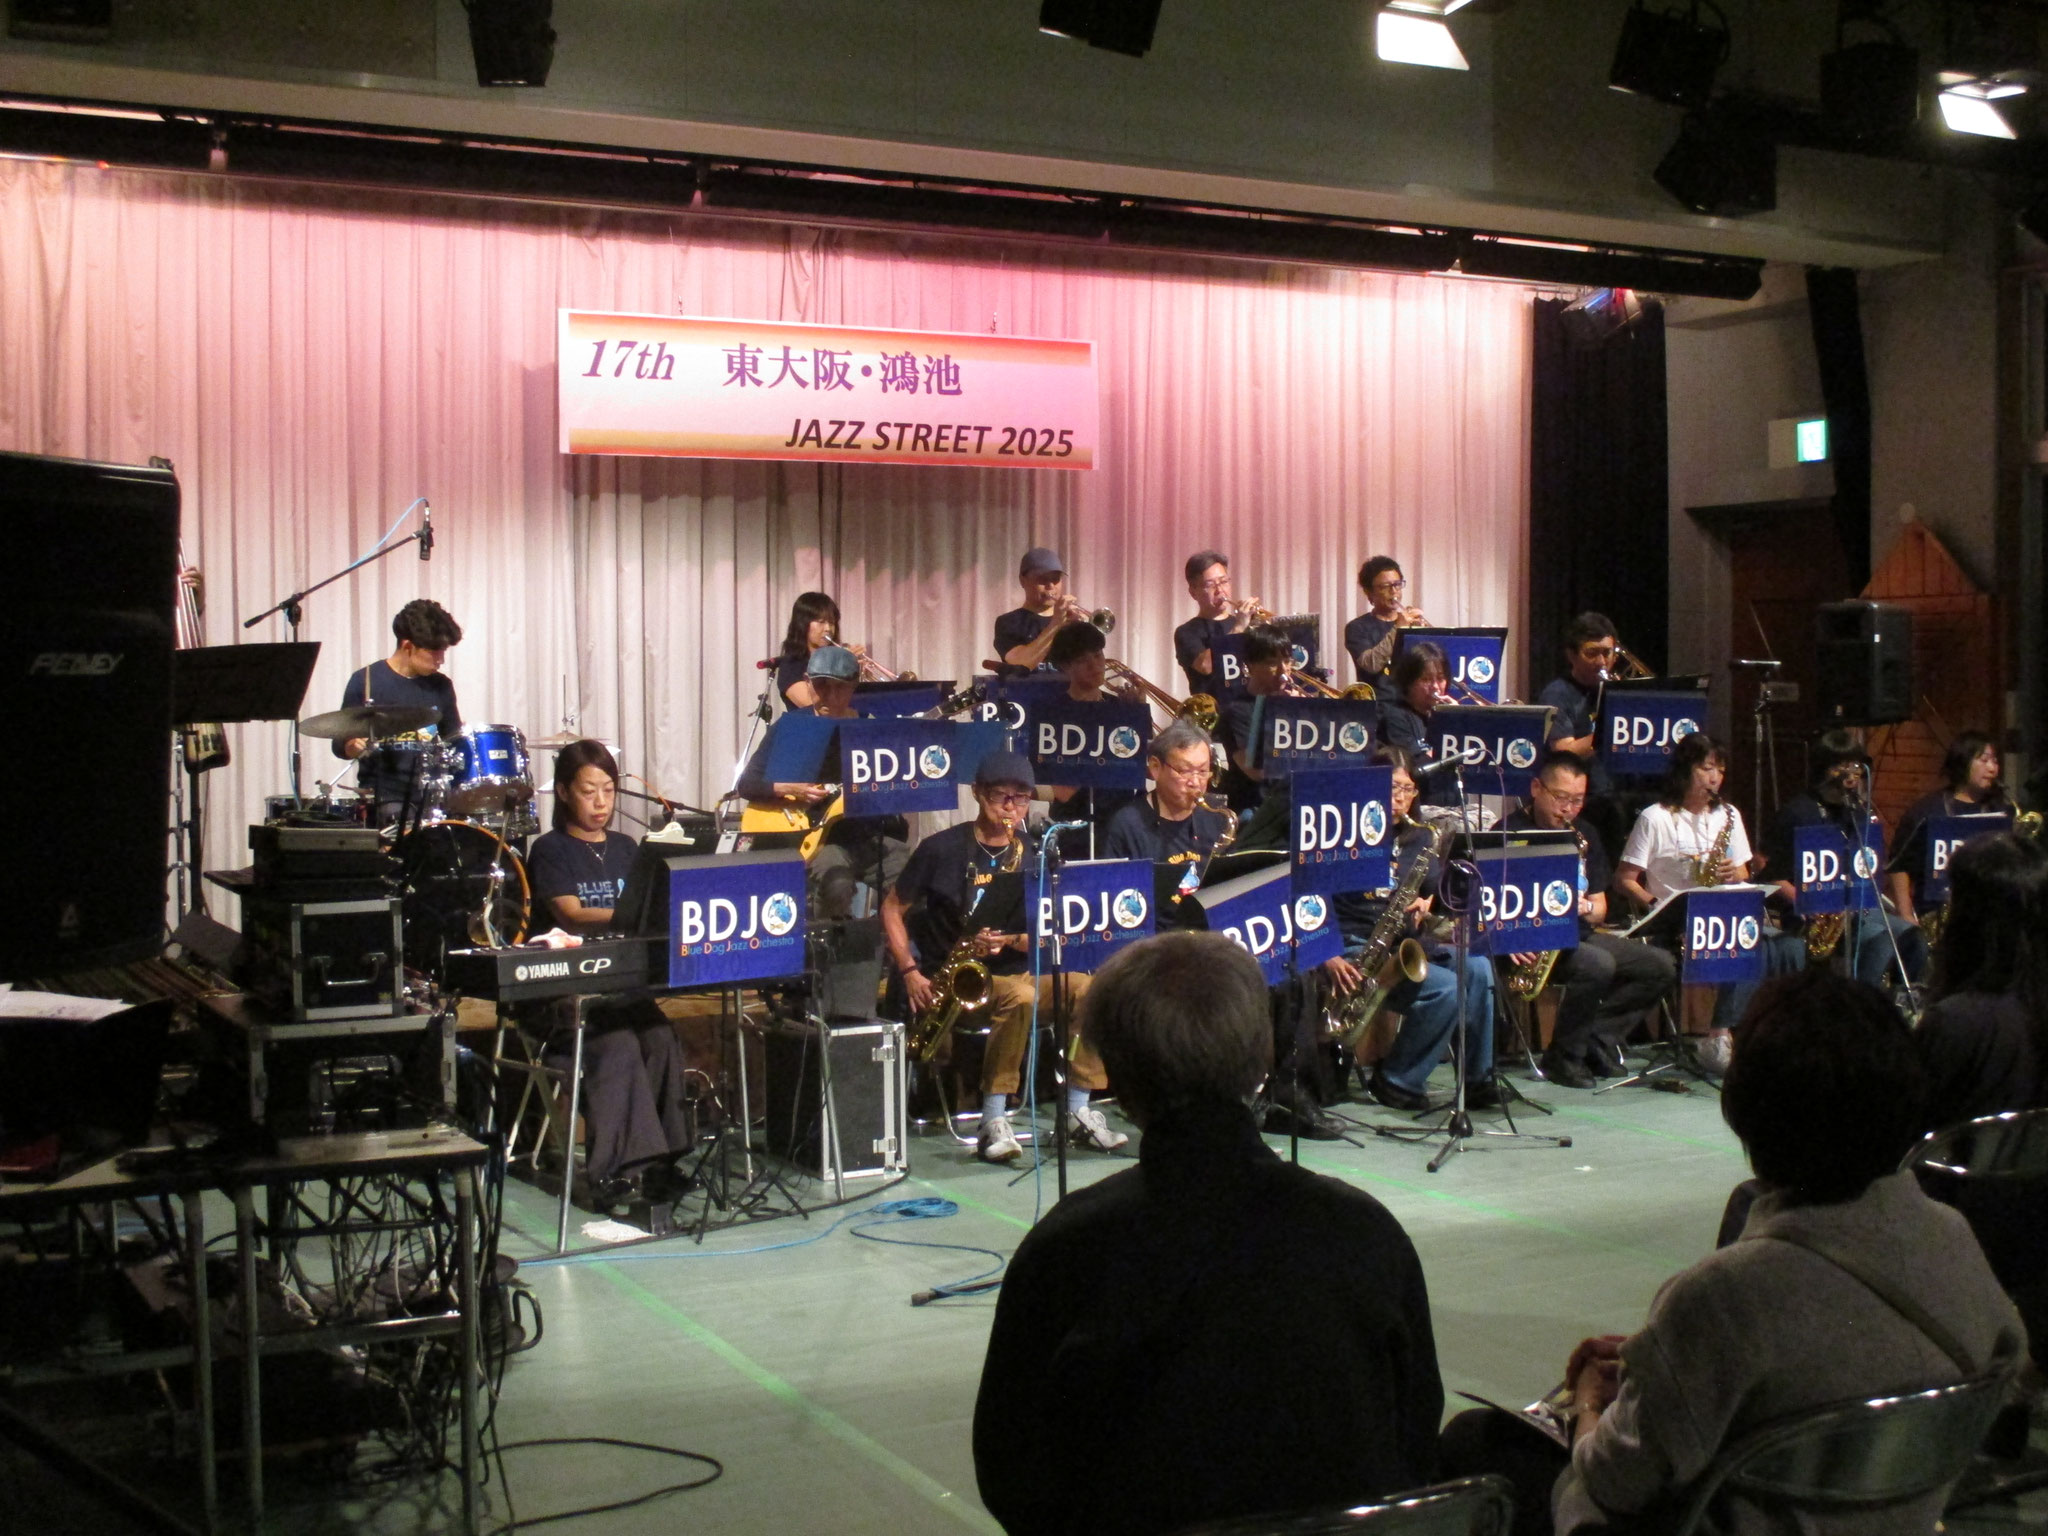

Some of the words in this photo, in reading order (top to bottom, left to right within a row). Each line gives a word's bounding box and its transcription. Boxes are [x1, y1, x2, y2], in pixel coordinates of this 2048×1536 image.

[582, 339, 676, 381] 17th
[721, 342, 964, 396] 東大阪・鴻池
[785, 417, 867, 450] JAZZ
[872, 422, 993, 455] STREET
[998, 426, 1076, 458] 2025
[1038, 722, 1141, 759] BDJO
[1273, 718, 1369, 753] BDJO
[1613, 715, 1700, 747] BDJO
[851, 744, 951, 784] BDJO
[1441, 733, 1538, 769] BDJO
[1299, 800, 1387, 852] BDJO
[1802, 846, 1878, 883] BDO
[682, 892, 798, 945] BDJO
[1039, 888, 1147, 937] BDJO
[1478, 880, 1573, 922] BDJO
[681, 944, 703, 957] Blue
[704, 942, 725, 956] Dog
[726, 940, 749, 953] Jazz
[749, 936, 796, 951] Orchestra
[1692, 915, 1759, 950] BDJO
[528, 961, 571, 979] YAMAHA
[579, 958, 612, 974] CP
